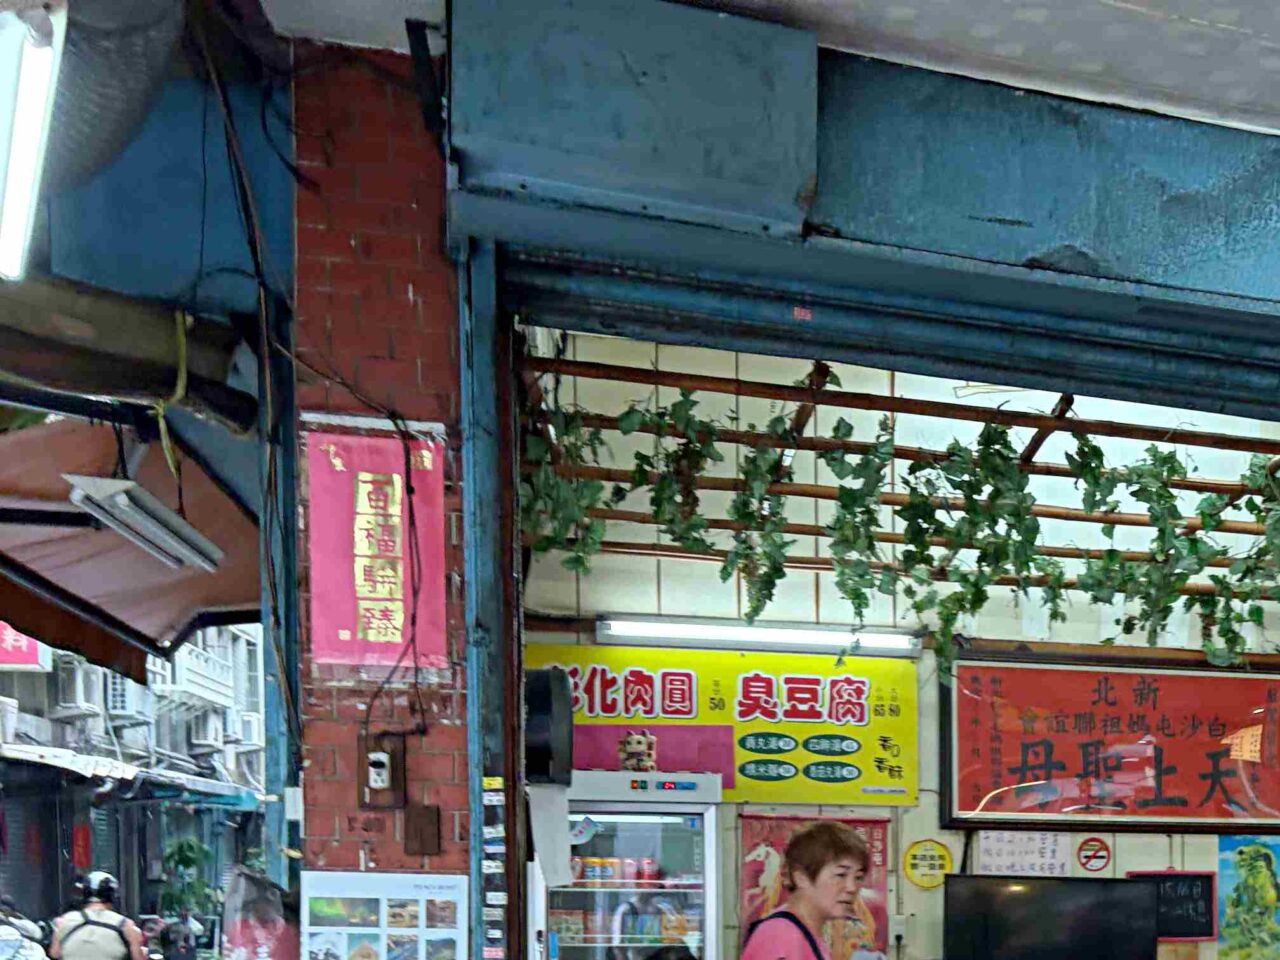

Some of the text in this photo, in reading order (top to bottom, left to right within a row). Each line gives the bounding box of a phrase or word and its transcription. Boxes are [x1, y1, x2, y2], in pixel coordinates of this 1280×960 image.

[571, 667, 696, 717] 化肉圓
[736, 672, 867, 724] 臭豆腐
[1091, 676, 1160, 710] 新北
[1007, 738, 1249, 814] 天上聖母
